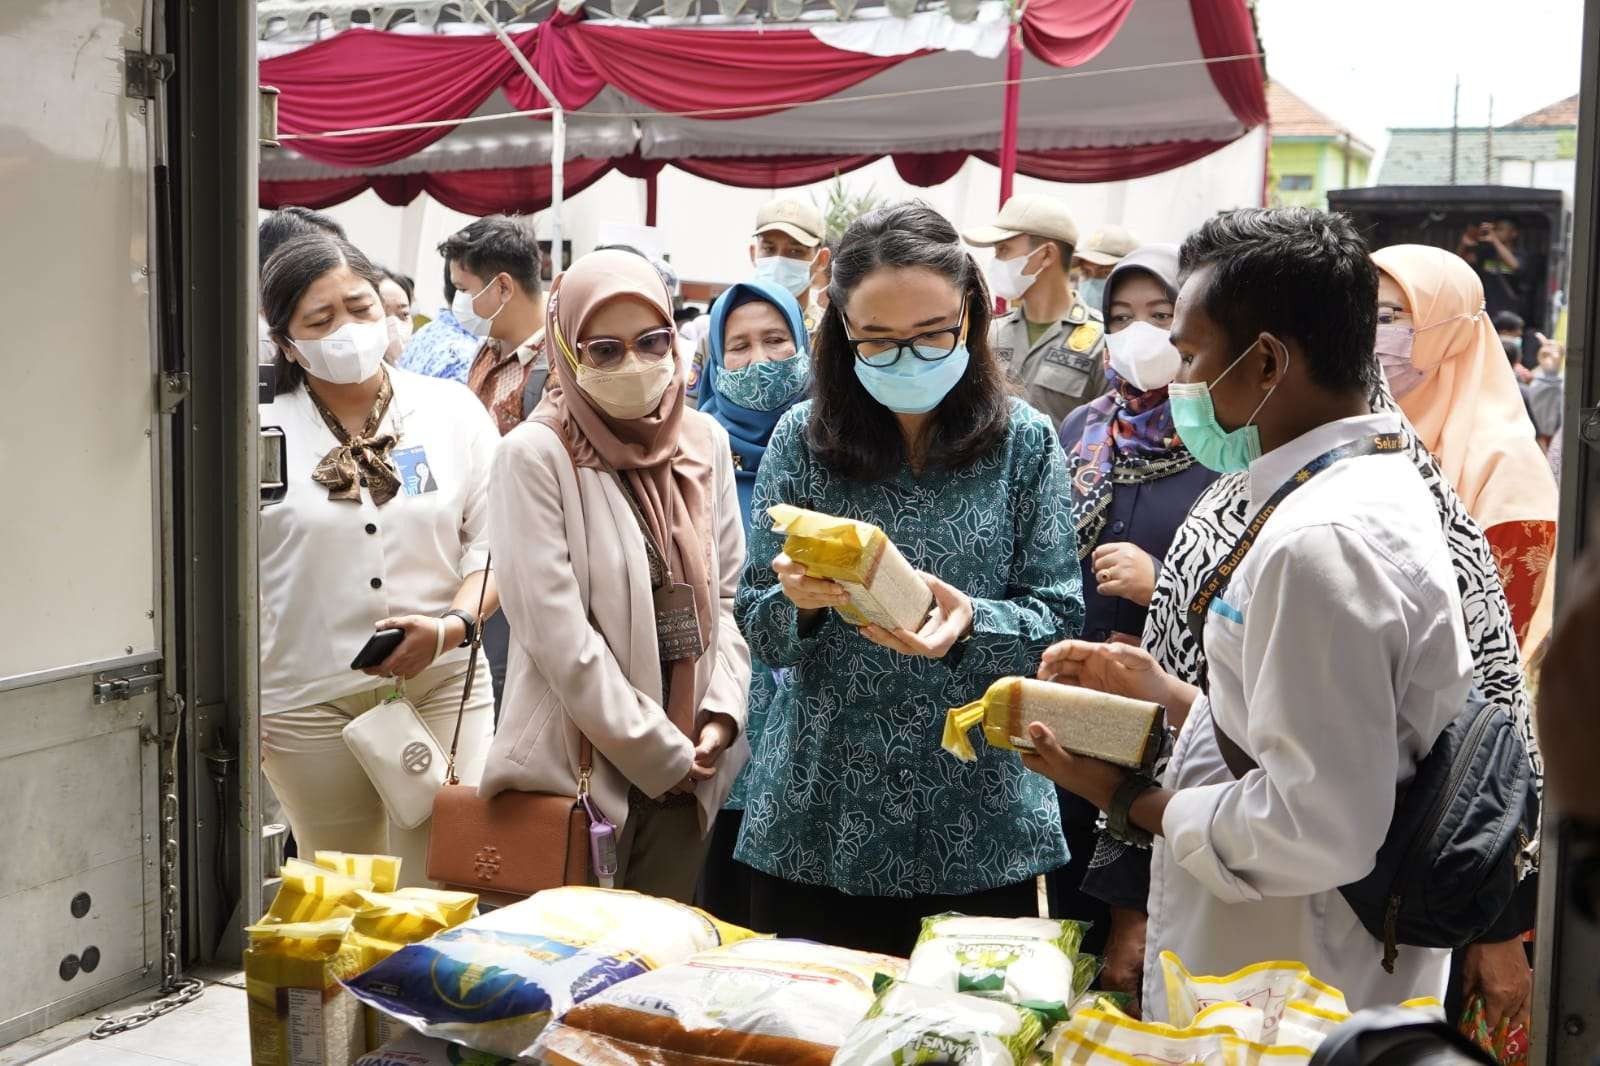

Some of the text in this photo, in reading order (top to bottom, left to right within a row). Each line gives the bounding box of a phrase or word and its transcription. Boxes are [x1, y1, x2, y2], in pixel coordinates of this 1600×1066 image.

[1050, 351, 1070, 365] POL
[1375, 437, 1398, 449] Sekar
[1192, 505, 1275, 614] Sekar Bulog Jatim
